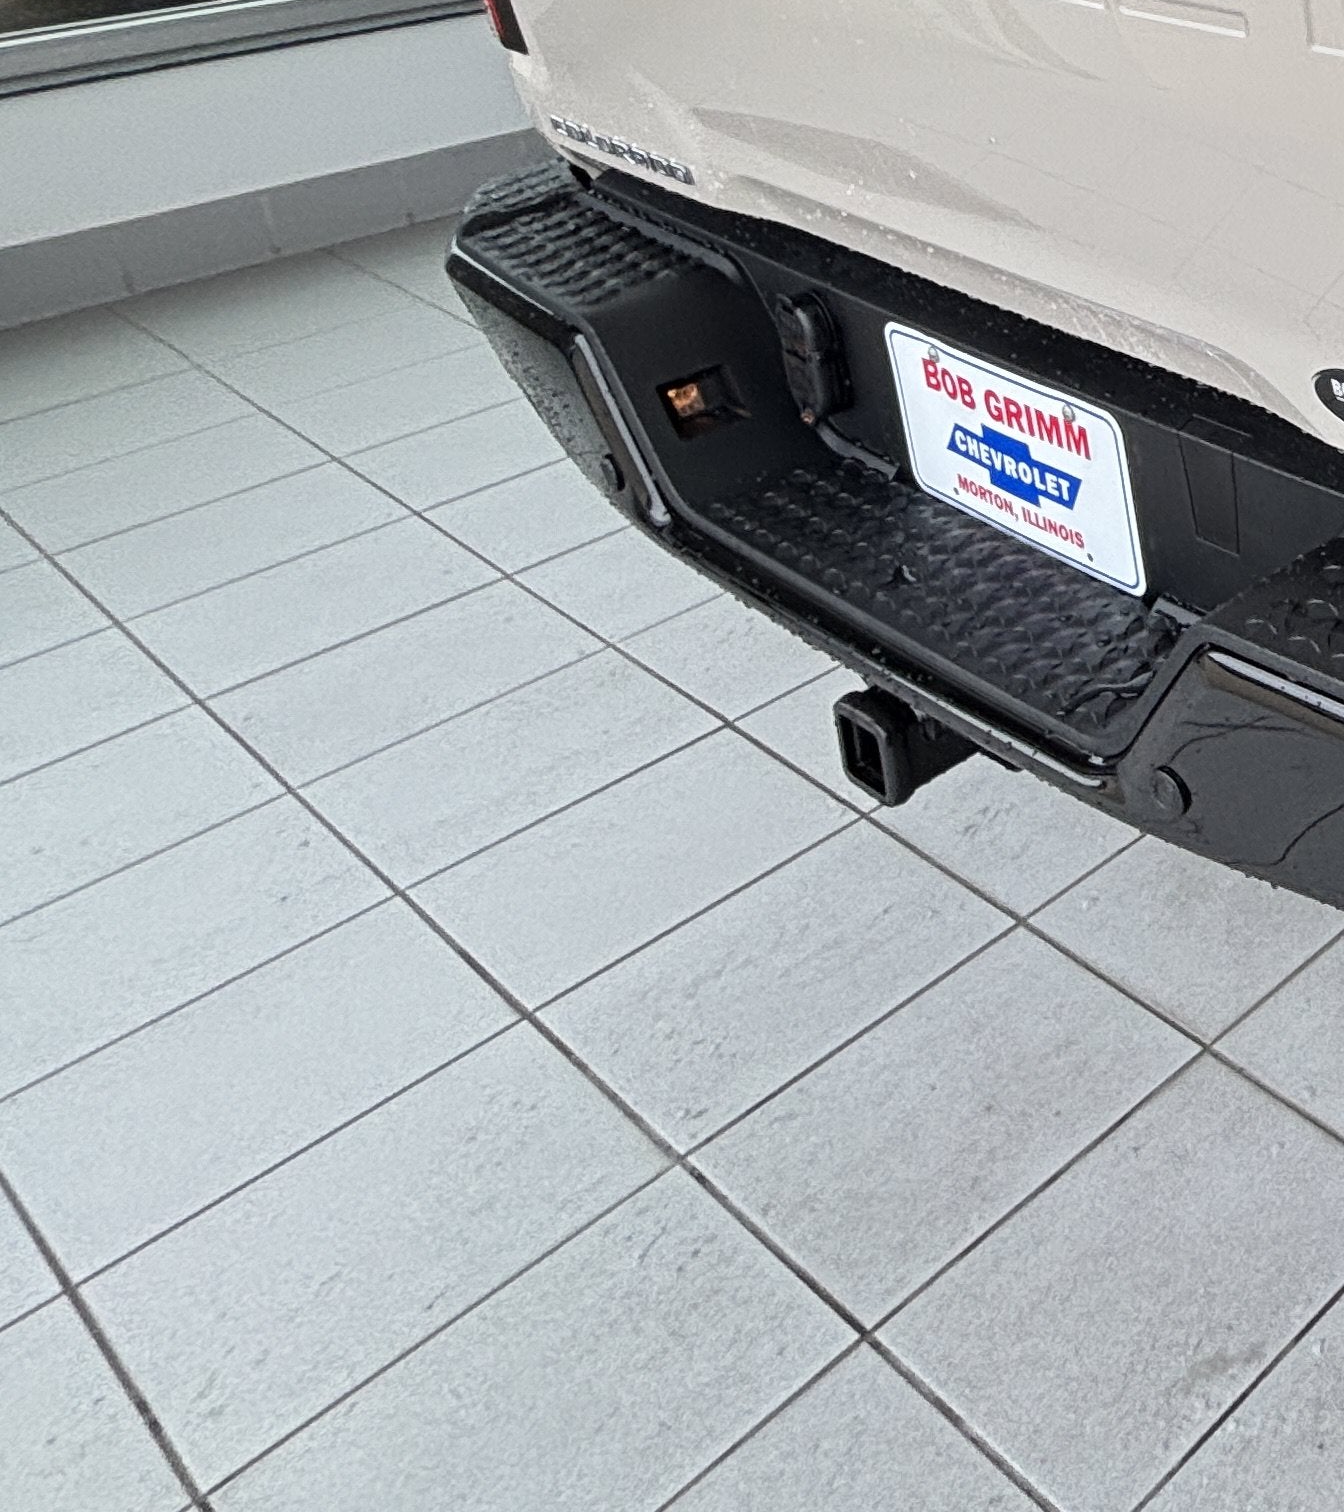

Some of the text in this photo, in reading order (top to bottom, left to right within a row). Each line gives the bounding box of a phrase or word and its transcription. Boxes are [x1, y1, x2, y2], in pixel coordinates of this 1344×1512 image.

[921, 357, 1093, 461] BOB GRIMM
[954, 429, 1071, 503] CHEVROLET
[957, 473, 1086, 550] MORTON, ILLINOIS
